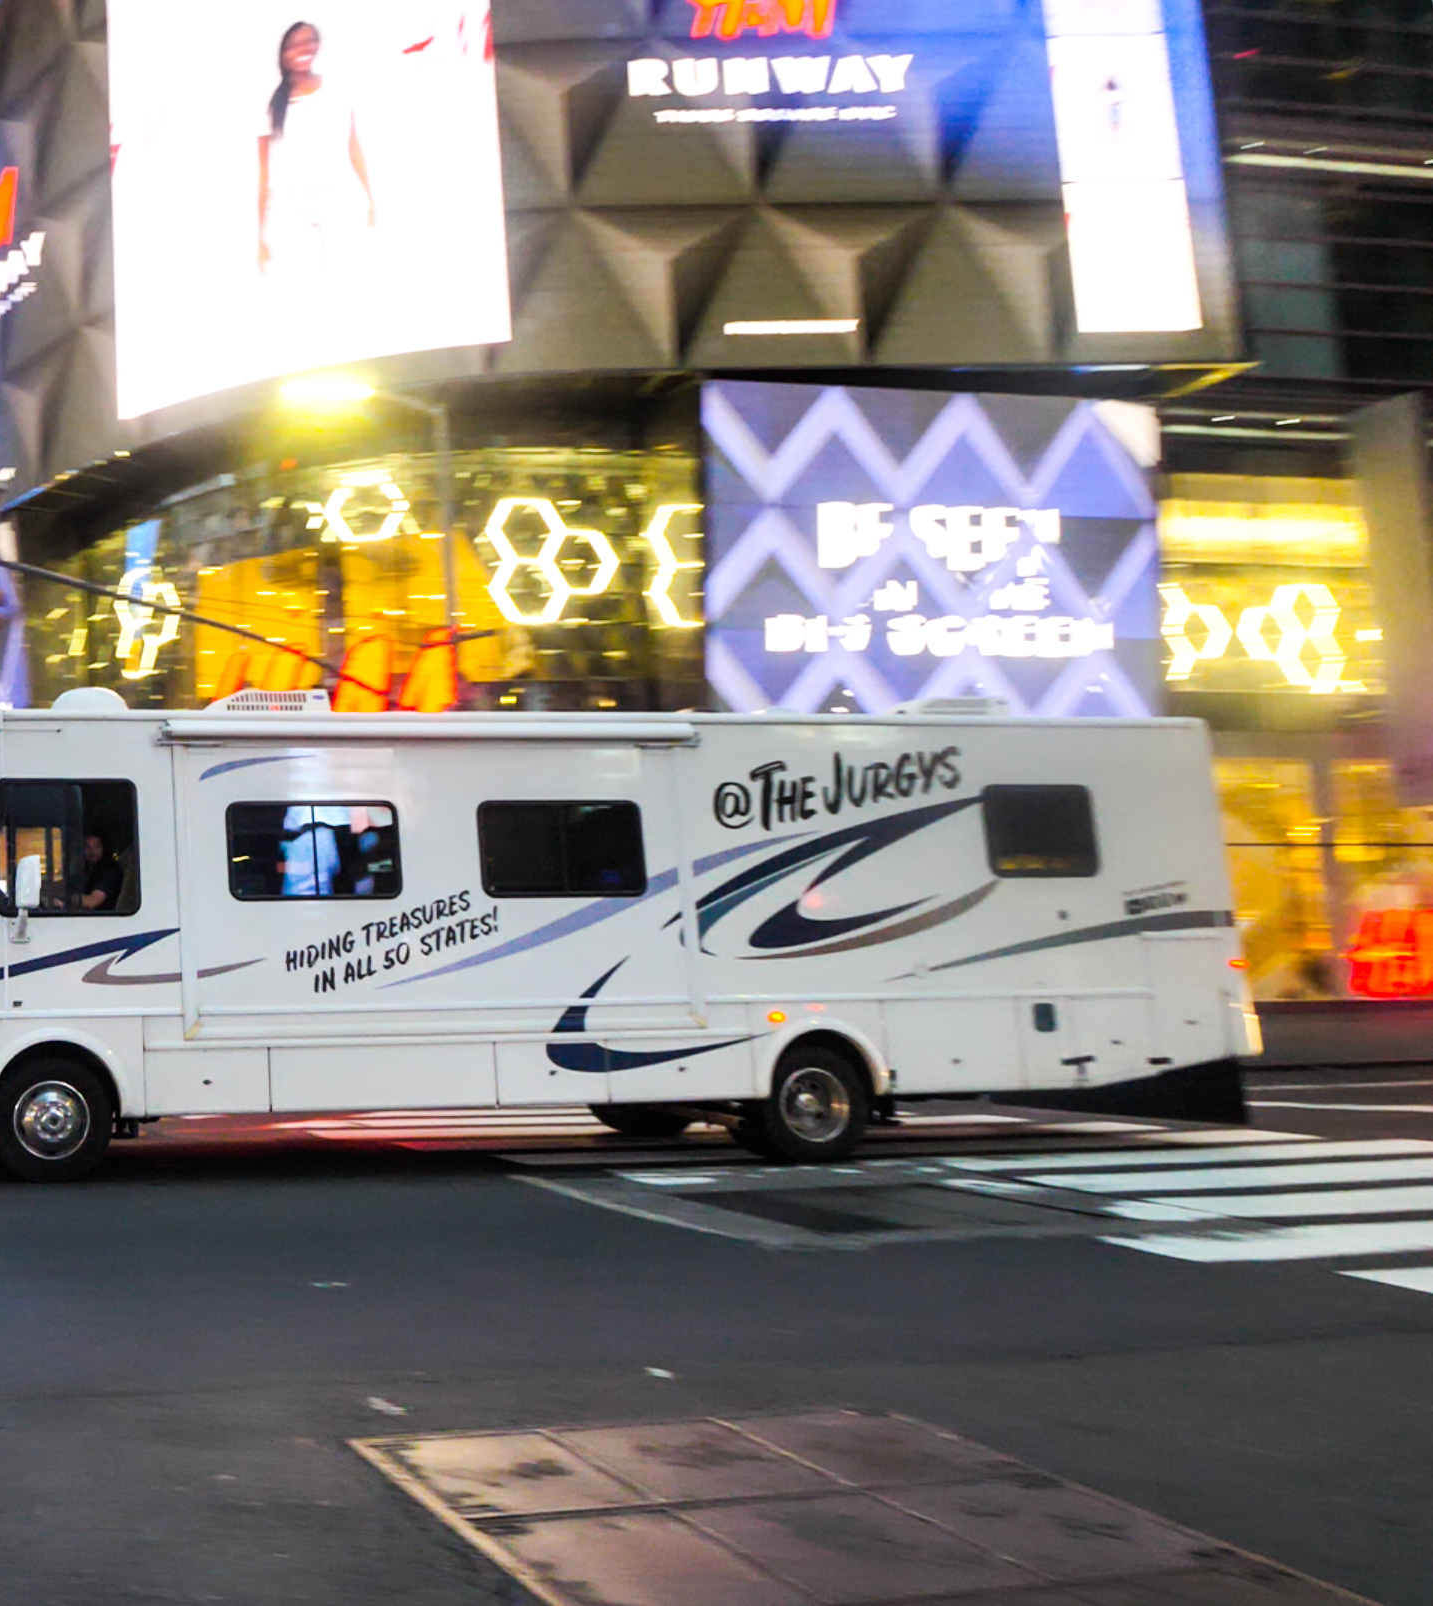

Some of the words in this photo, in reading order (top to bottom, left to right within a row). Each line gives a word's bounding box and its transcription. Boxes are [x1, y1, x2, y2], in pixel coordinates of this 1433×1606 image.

[627, 53, 915, 98] RUNWAY
[285, 930, 356, 972] HIDING
[361, 890, 471, 946] TREASURES
[314, 966, 336, 993] IN
[343, 955, 377, 984] ALL
[382, 942, 410, 970] 50
[420, 905, 499, 956] STATES!
